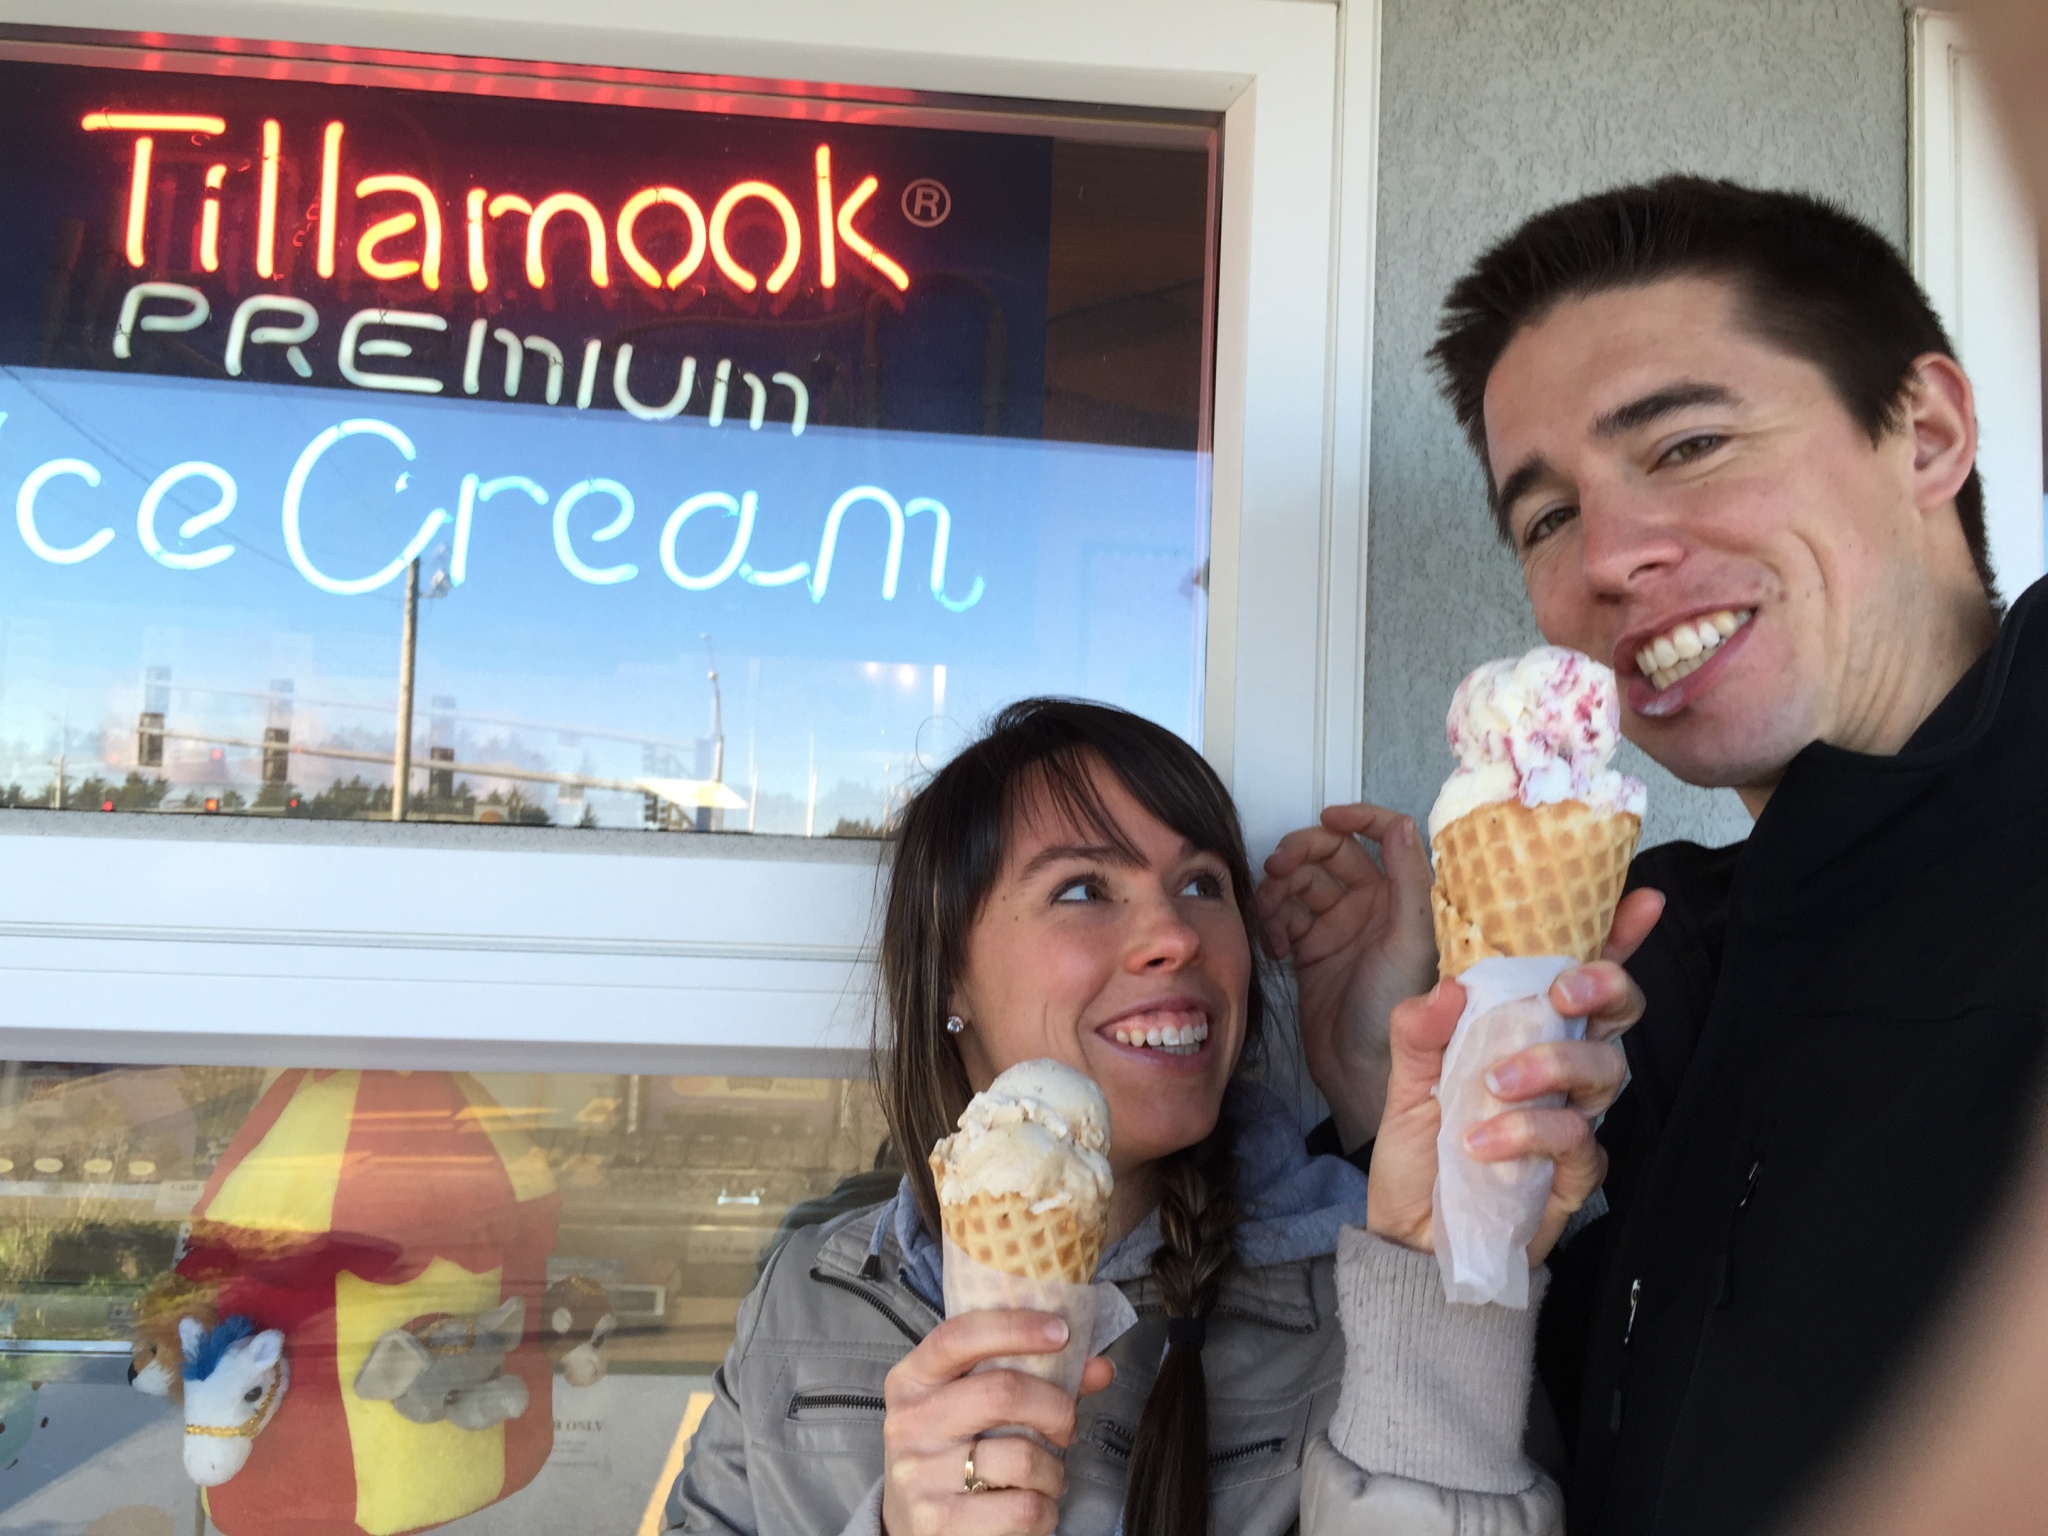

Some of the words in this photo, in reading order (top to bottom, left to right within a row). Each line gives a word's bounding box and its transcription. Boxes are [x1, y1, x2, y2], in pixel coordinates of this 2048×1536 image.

[81, 110, 911, 292] Tillamook
[112, 281, 810, 437] PREMIUM
[0, 411, 238, 570] ce
[282, 417, 987, 614] Cream
